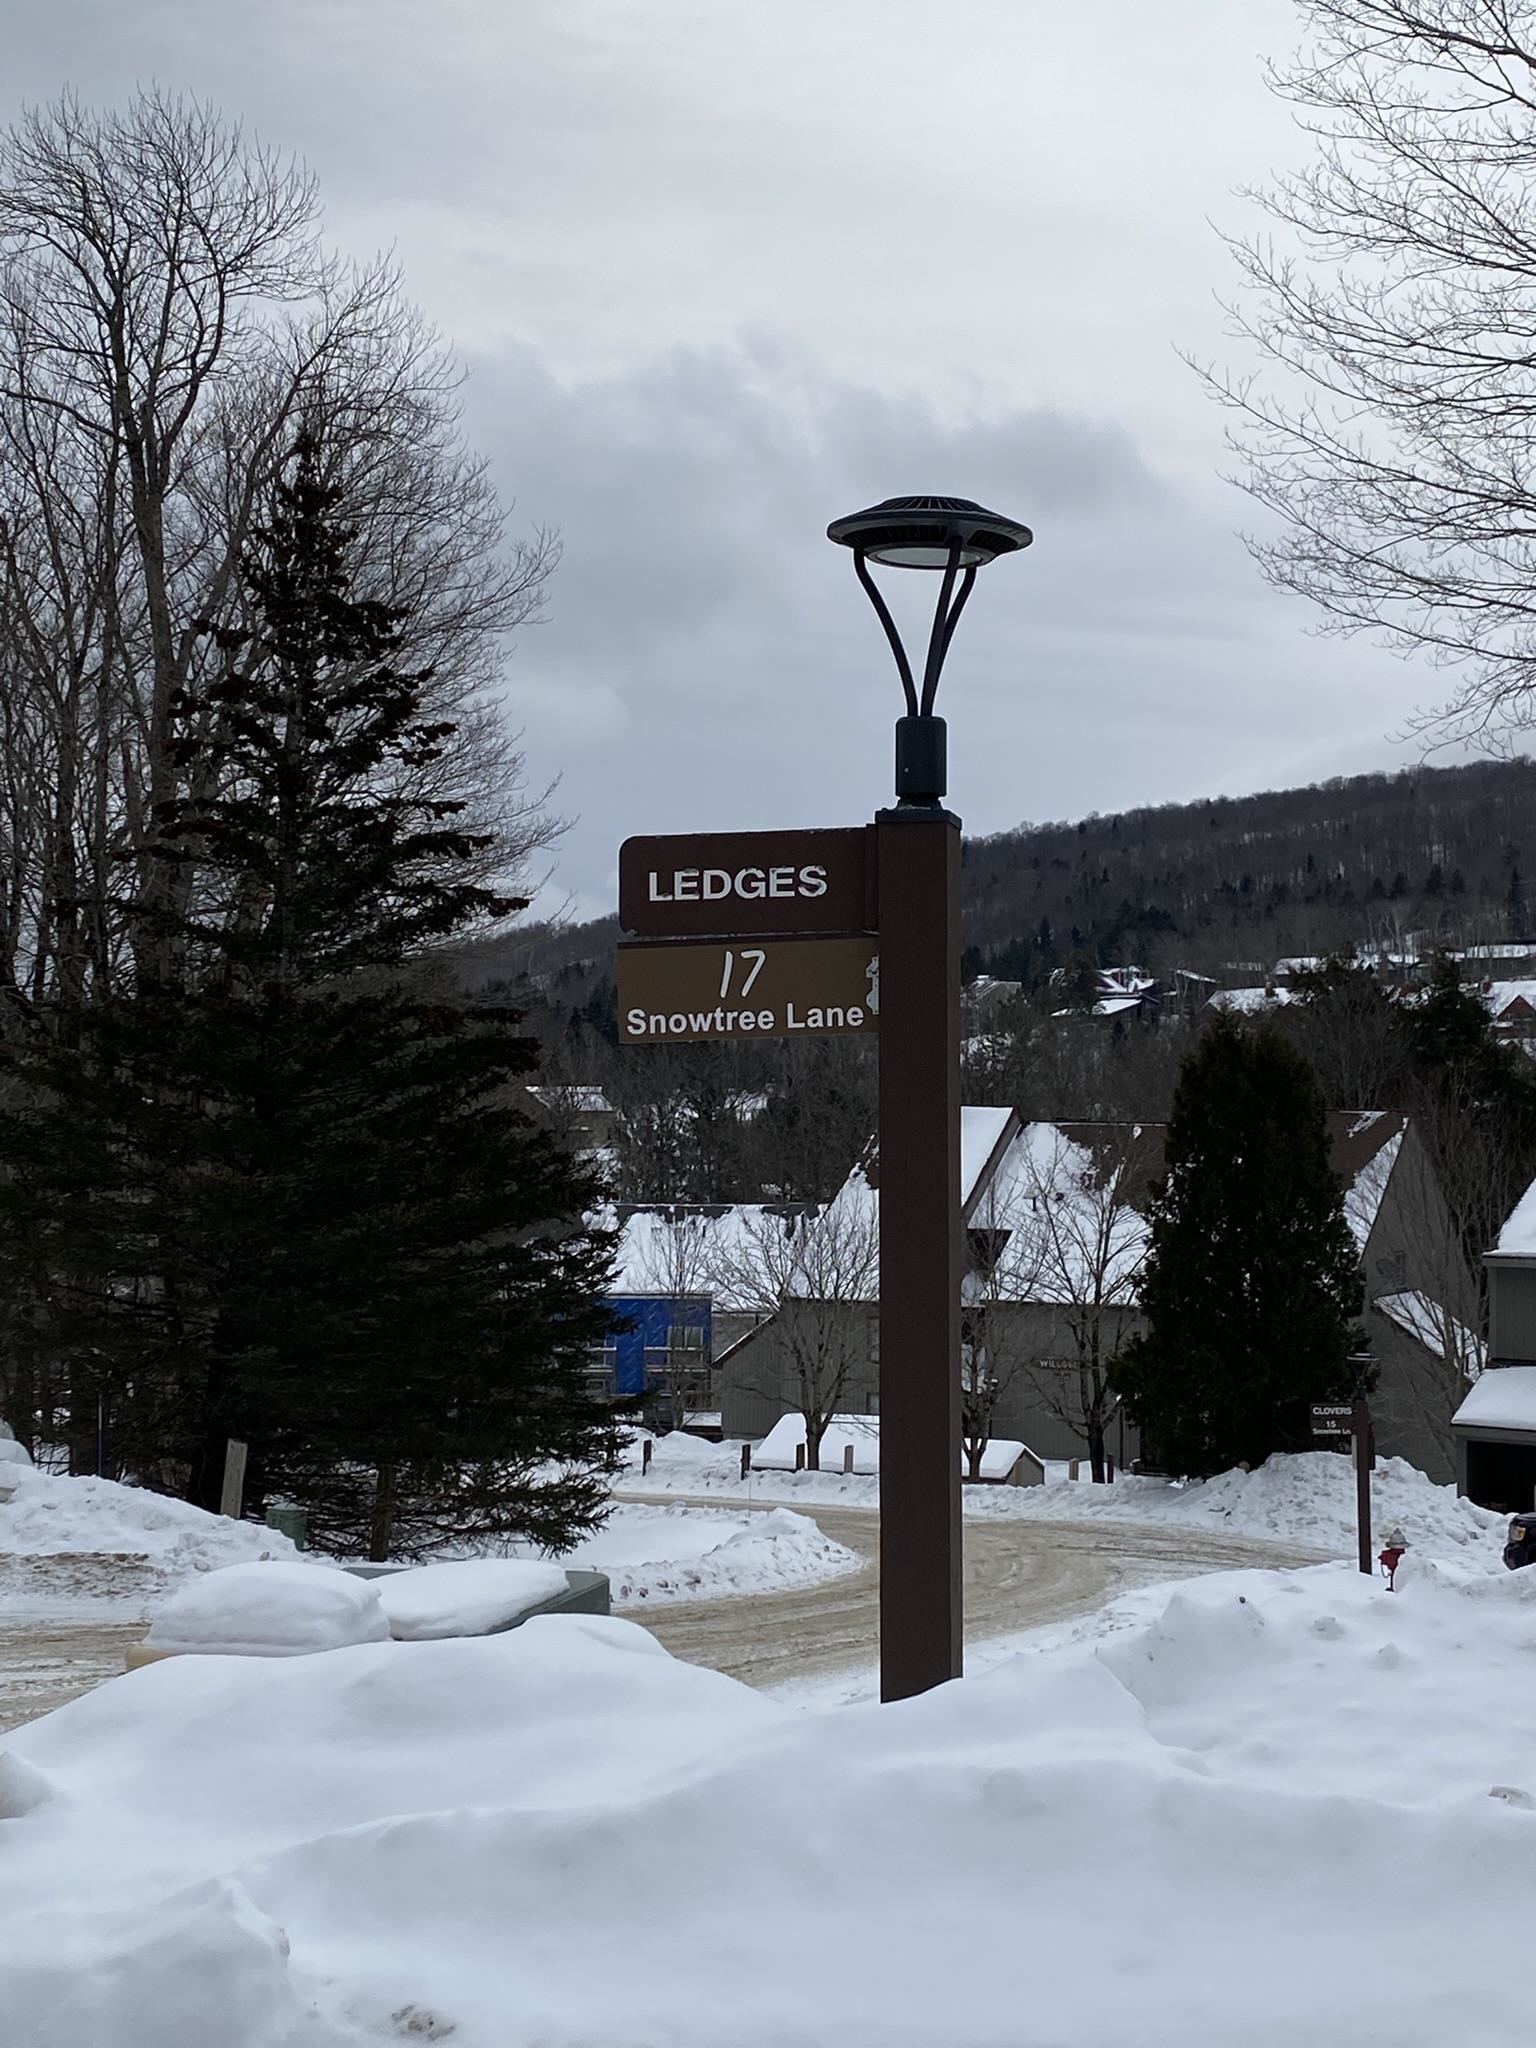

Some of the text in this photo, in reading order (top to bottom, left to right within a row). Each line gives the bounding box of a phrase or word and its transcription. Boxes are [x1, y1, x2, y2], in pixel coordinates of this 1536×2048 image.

[649, 865, 828, 902] LEDGES
[719, 949, 767, 999] 17
[626, 1002, 865, 1036] Snowtree Lane
[1312, 1406, 1352, 1415] CLOVERS
[1326, 1420, 1336, 1428] 15
